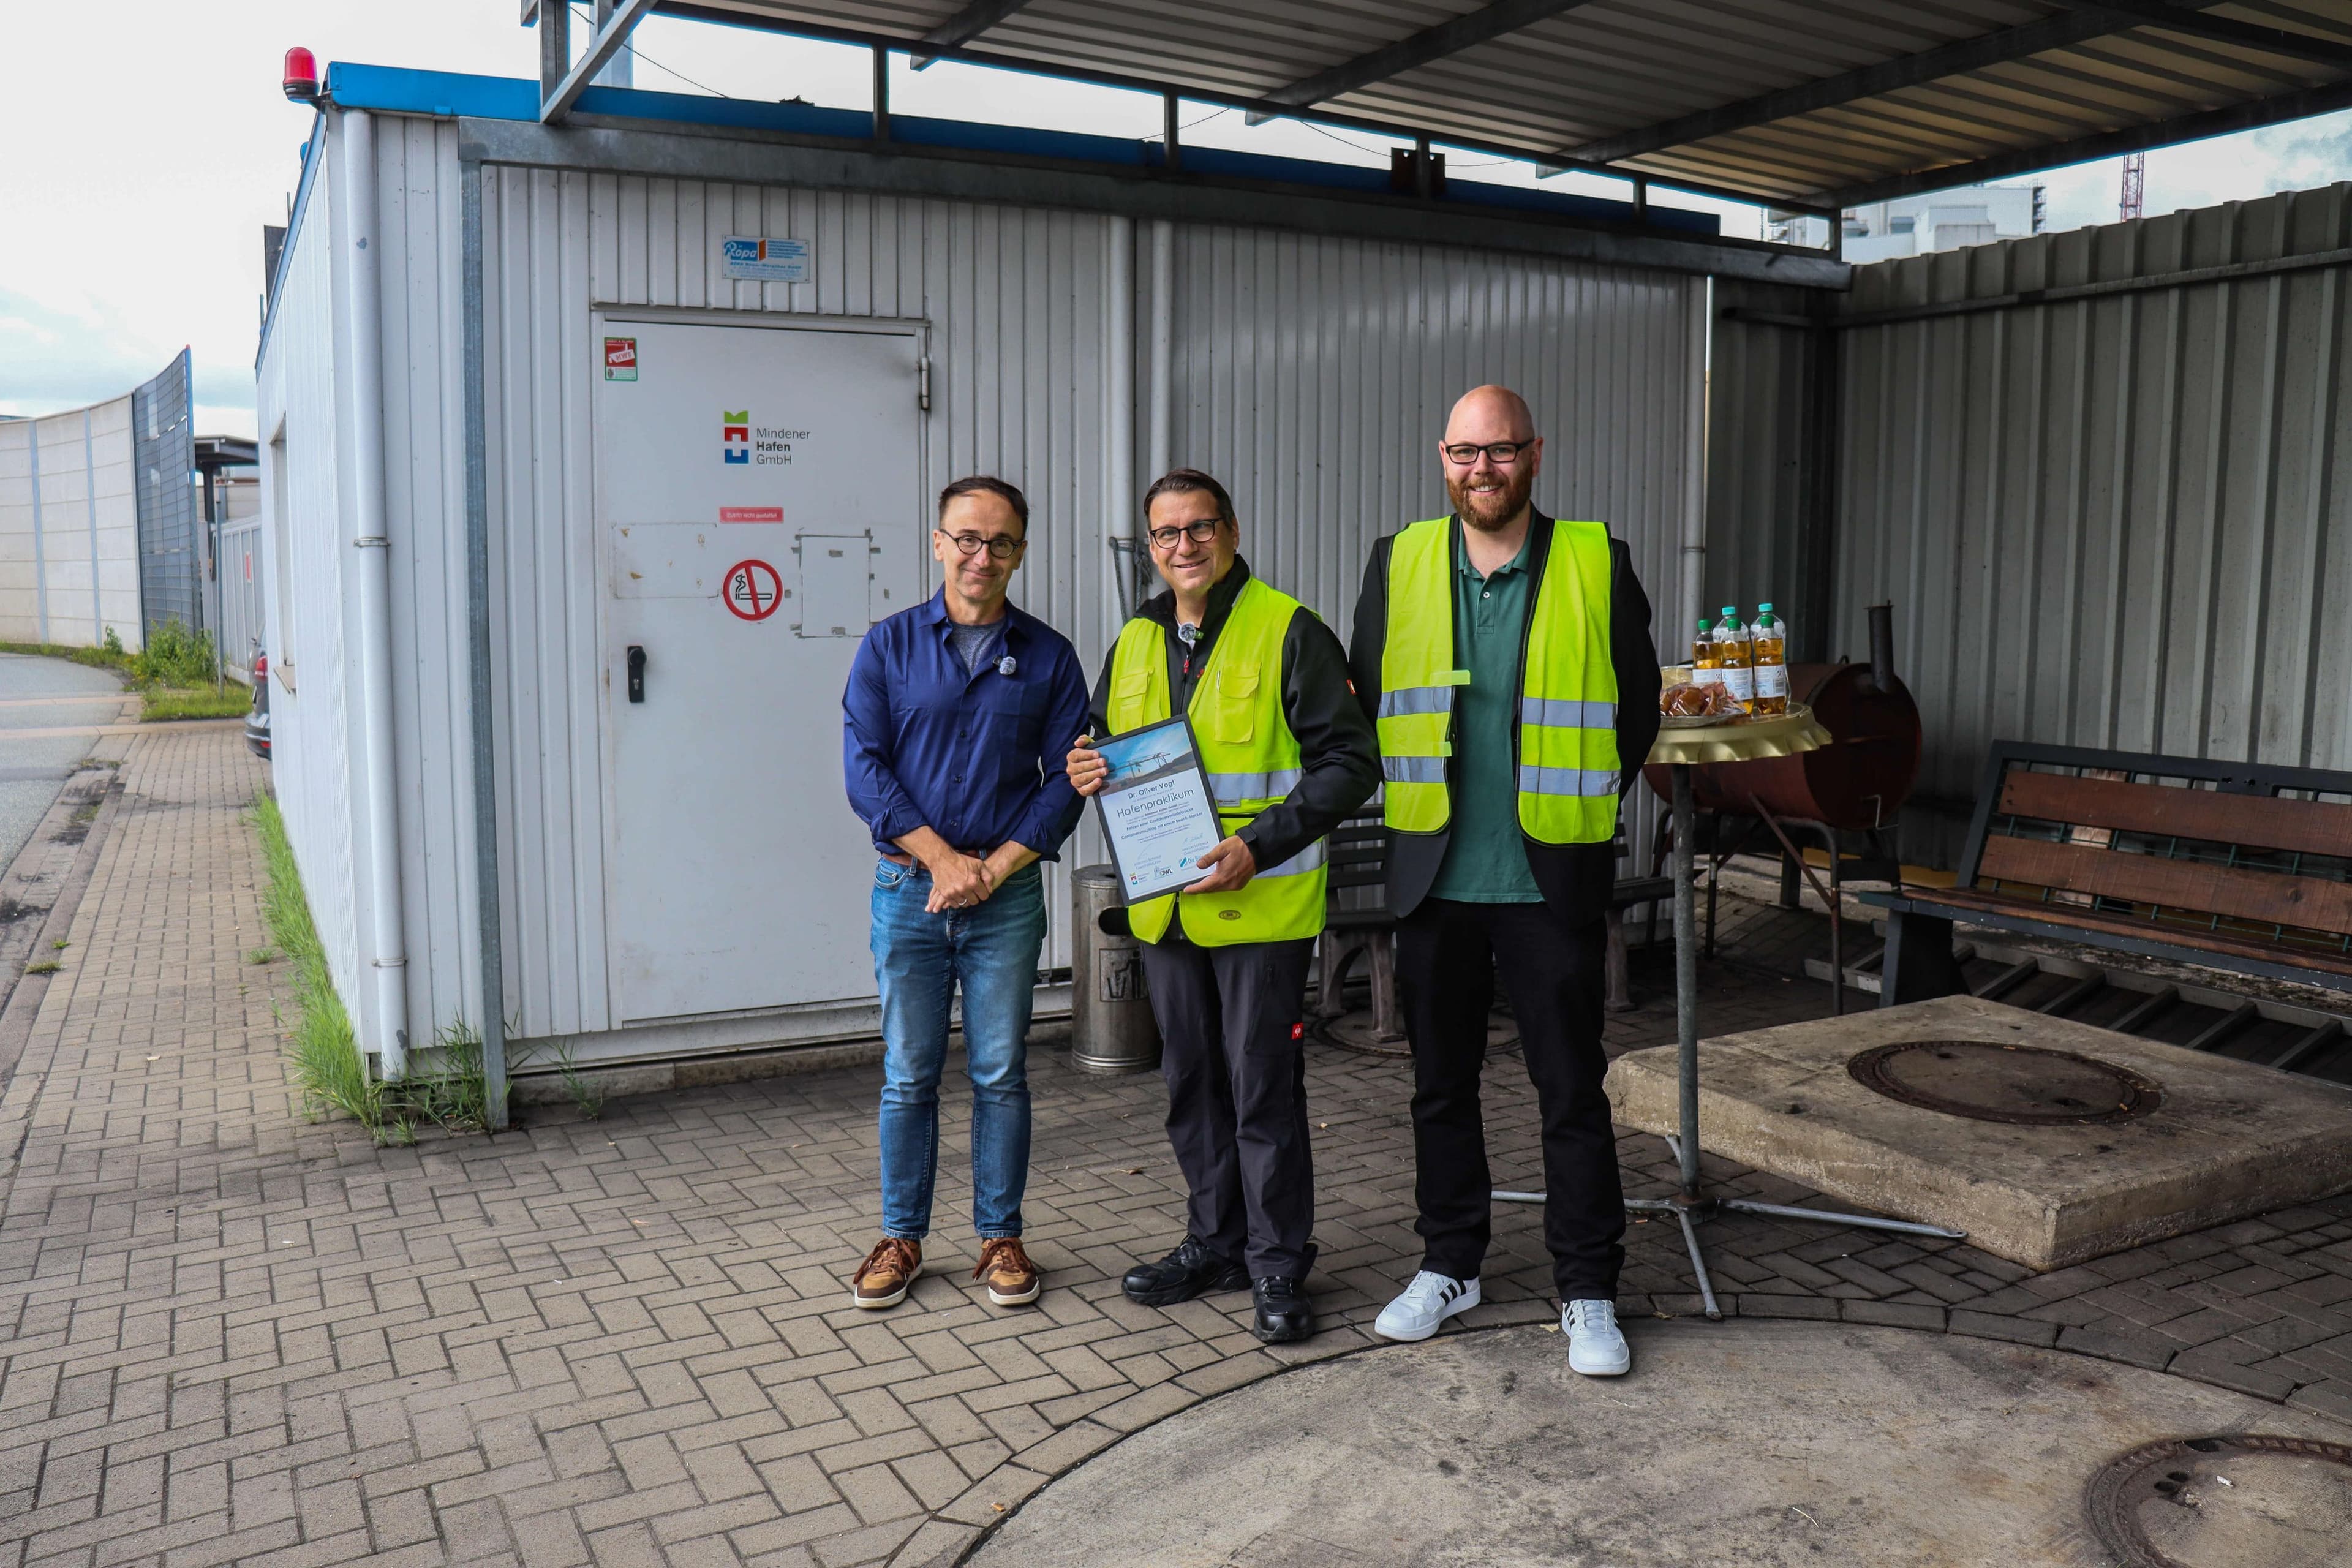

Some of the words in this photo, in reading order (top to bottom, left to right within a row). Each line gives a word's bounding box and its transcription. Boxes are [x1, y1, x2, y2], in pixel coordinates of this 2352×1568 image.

[756, 428, 811, 440] Mindener
[756, 441, 791, 452] Hafen
[756, 454, 792, 466] GmbH
[1139, 785, 1158, 796] Oliver
[1117, 787, 1195, 820] Hafenpraktikum
